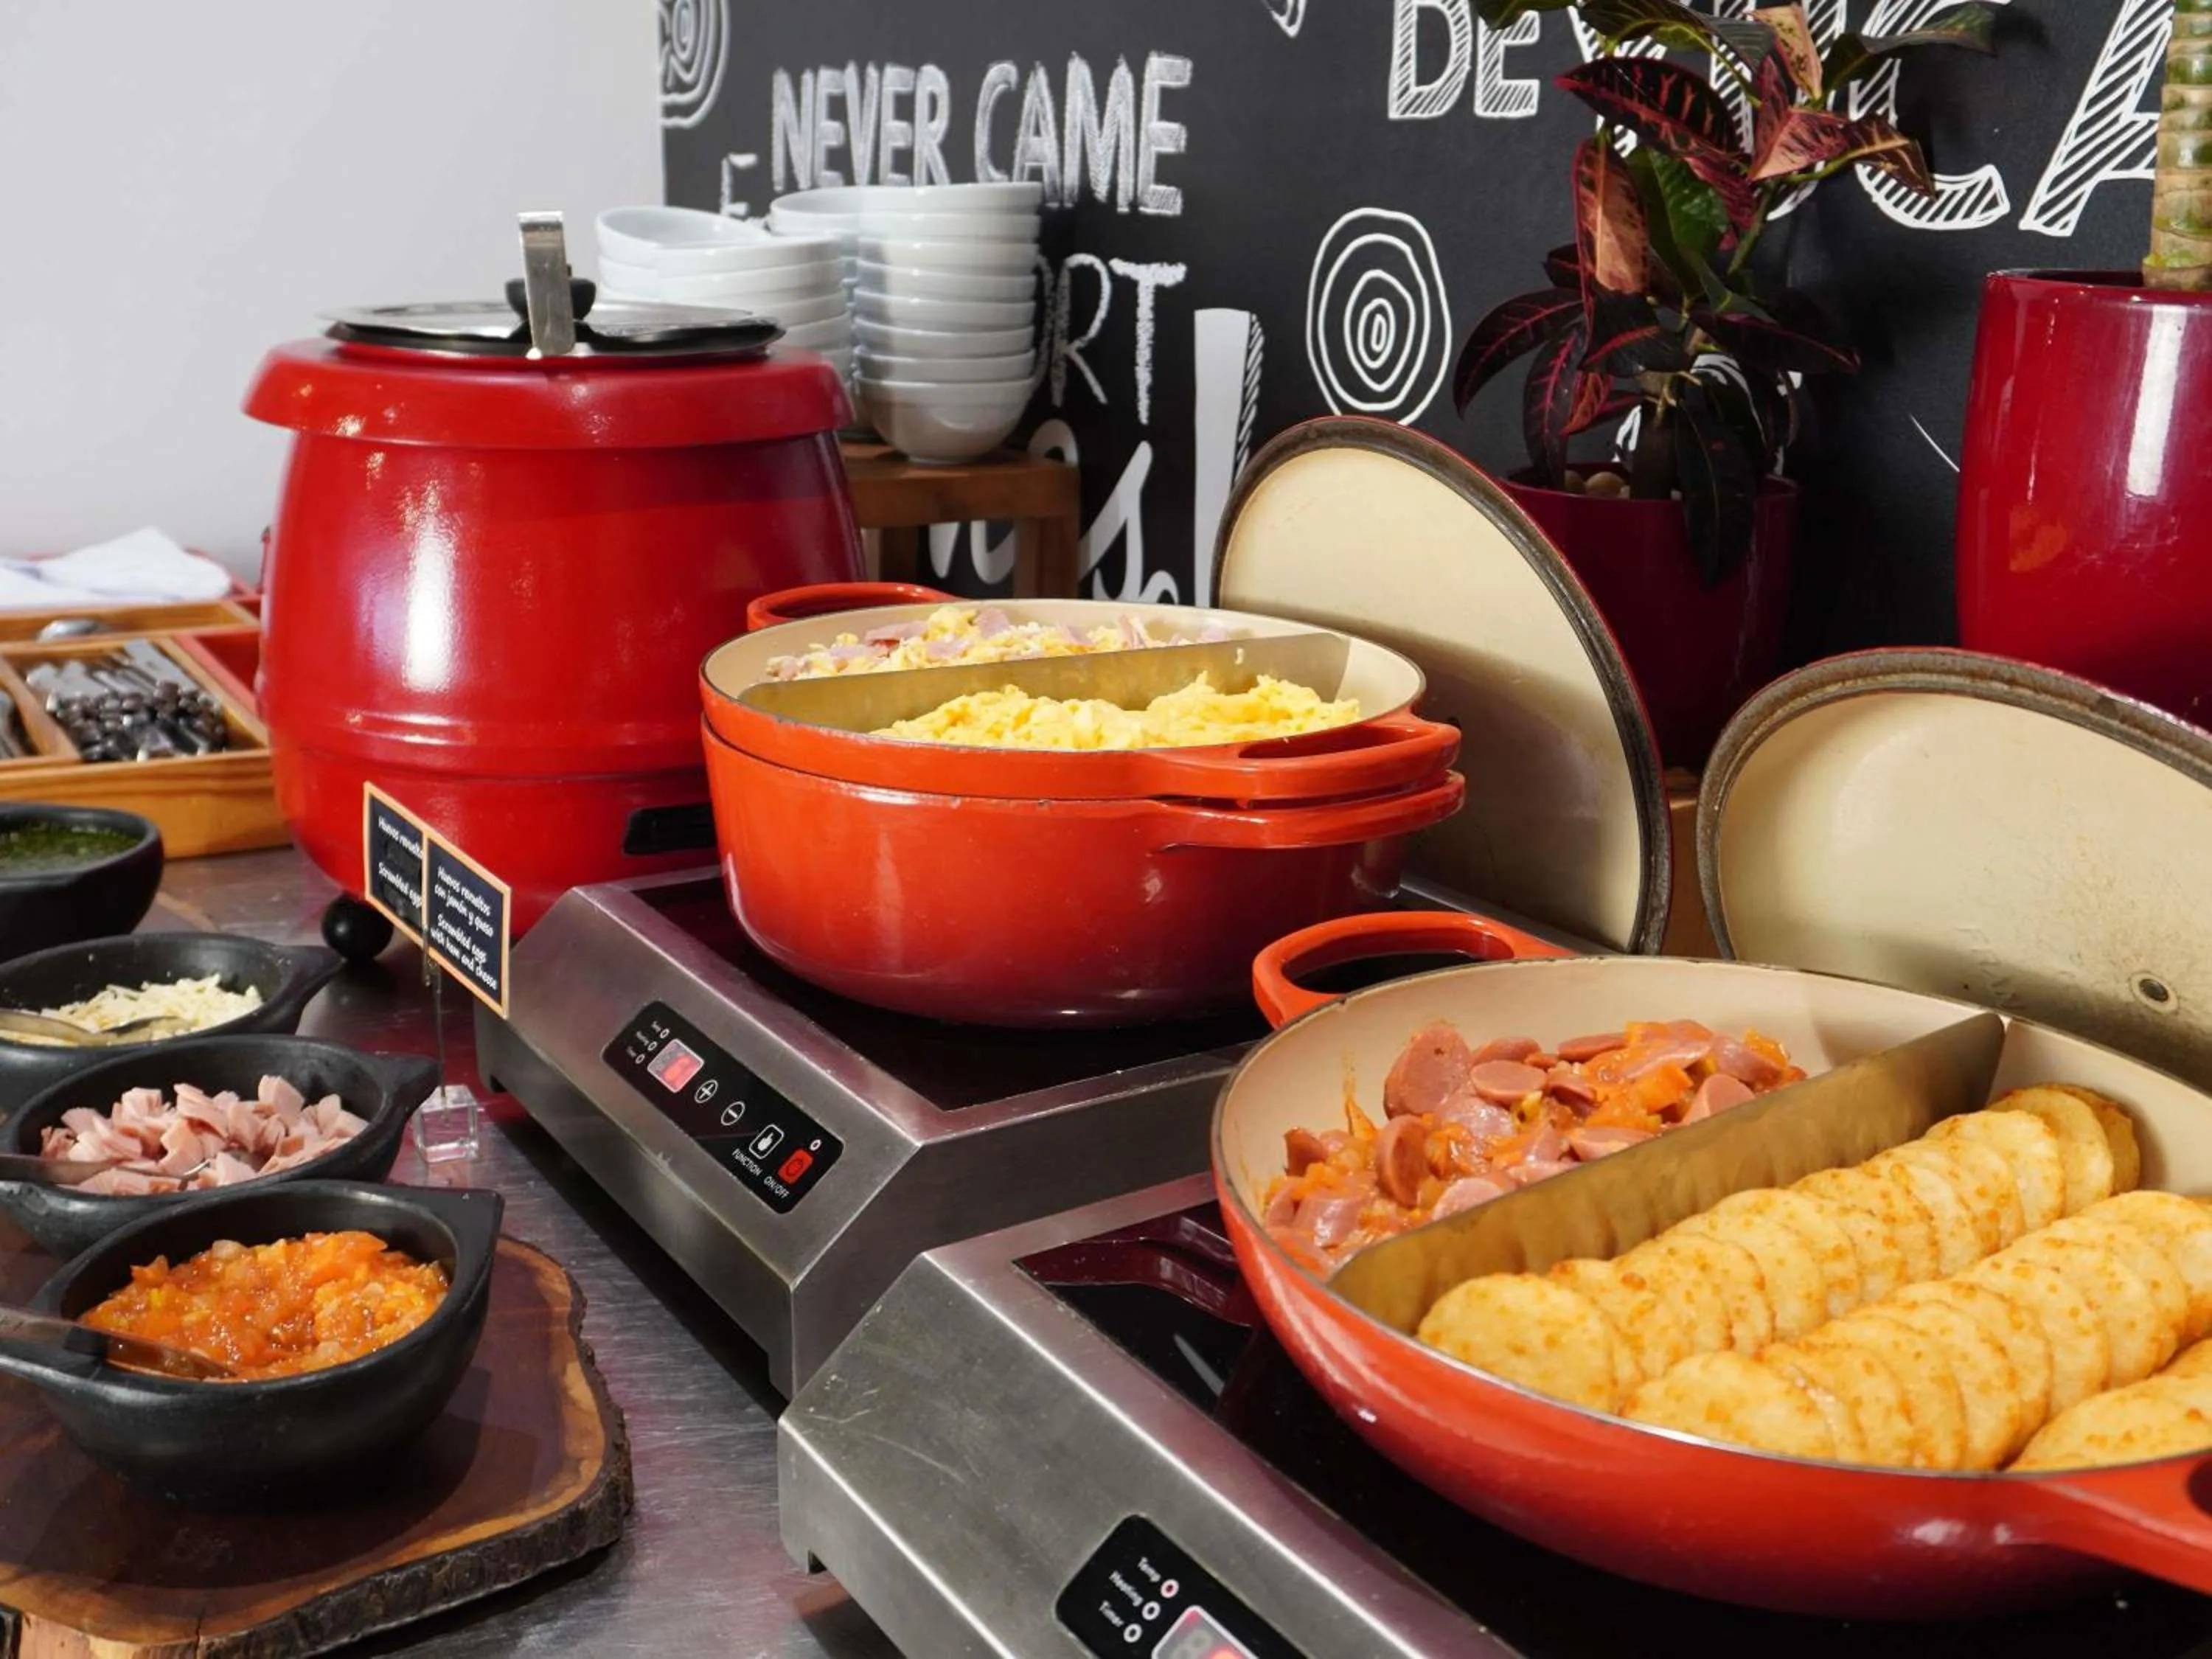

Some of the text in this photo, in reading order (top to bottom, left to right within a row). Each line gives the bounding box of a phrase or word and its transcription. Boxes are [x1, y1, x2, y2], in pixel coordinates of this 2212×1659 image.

[772, 60, 950, 192] NEVER
[975, 50, 1192, 215] CAME
[378, 862, 409, 895] Scrambled
[438, 866, 460, 893] Huevos
[438, 914, 470, 950] Scrambled
[468, 912, 474, 926] y
[475, 917, 493, 938] queso
[462, 954, 474, 972] and
[731, 1147, 790, 1200] FUNCTION ON/OFF
